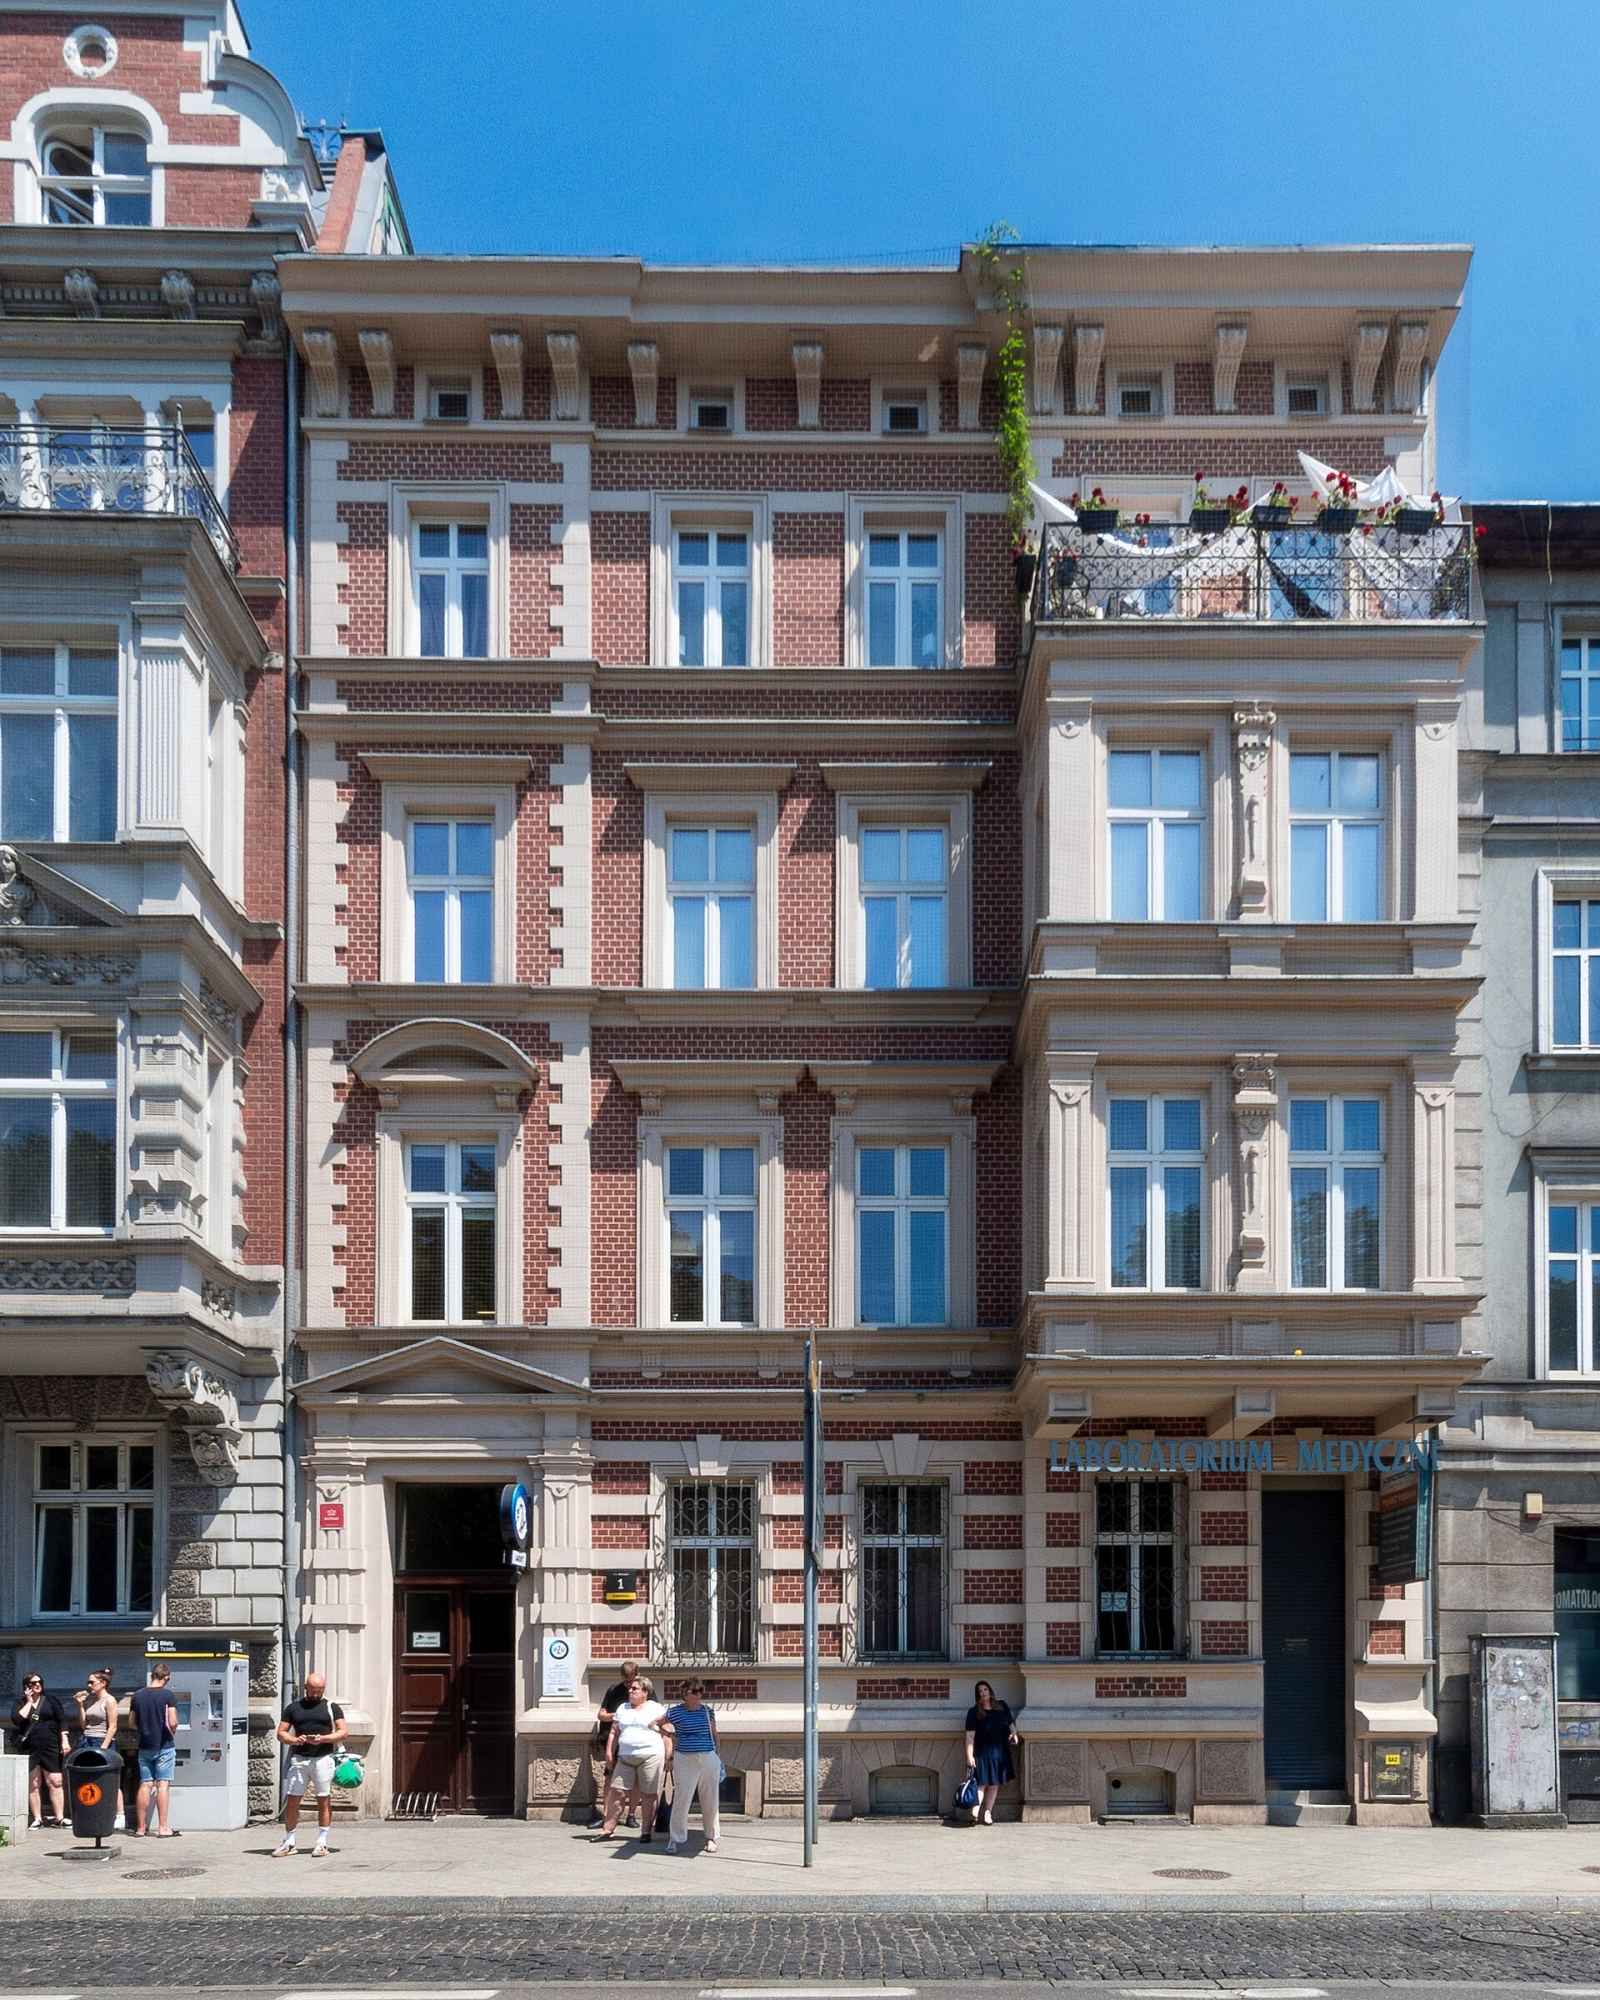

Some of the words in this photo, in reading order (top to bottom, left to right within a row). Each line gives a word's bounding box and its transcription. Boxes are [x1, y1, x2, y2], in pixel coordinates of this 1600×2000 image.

[1050, 1439, 1272, 1472] LABORATORIUM
[1298, 1439, 1443, 1473] MEDYCZNE
[617, 1578, 625, 1590] 1
[553, 1645, 566, 1655] PZU
